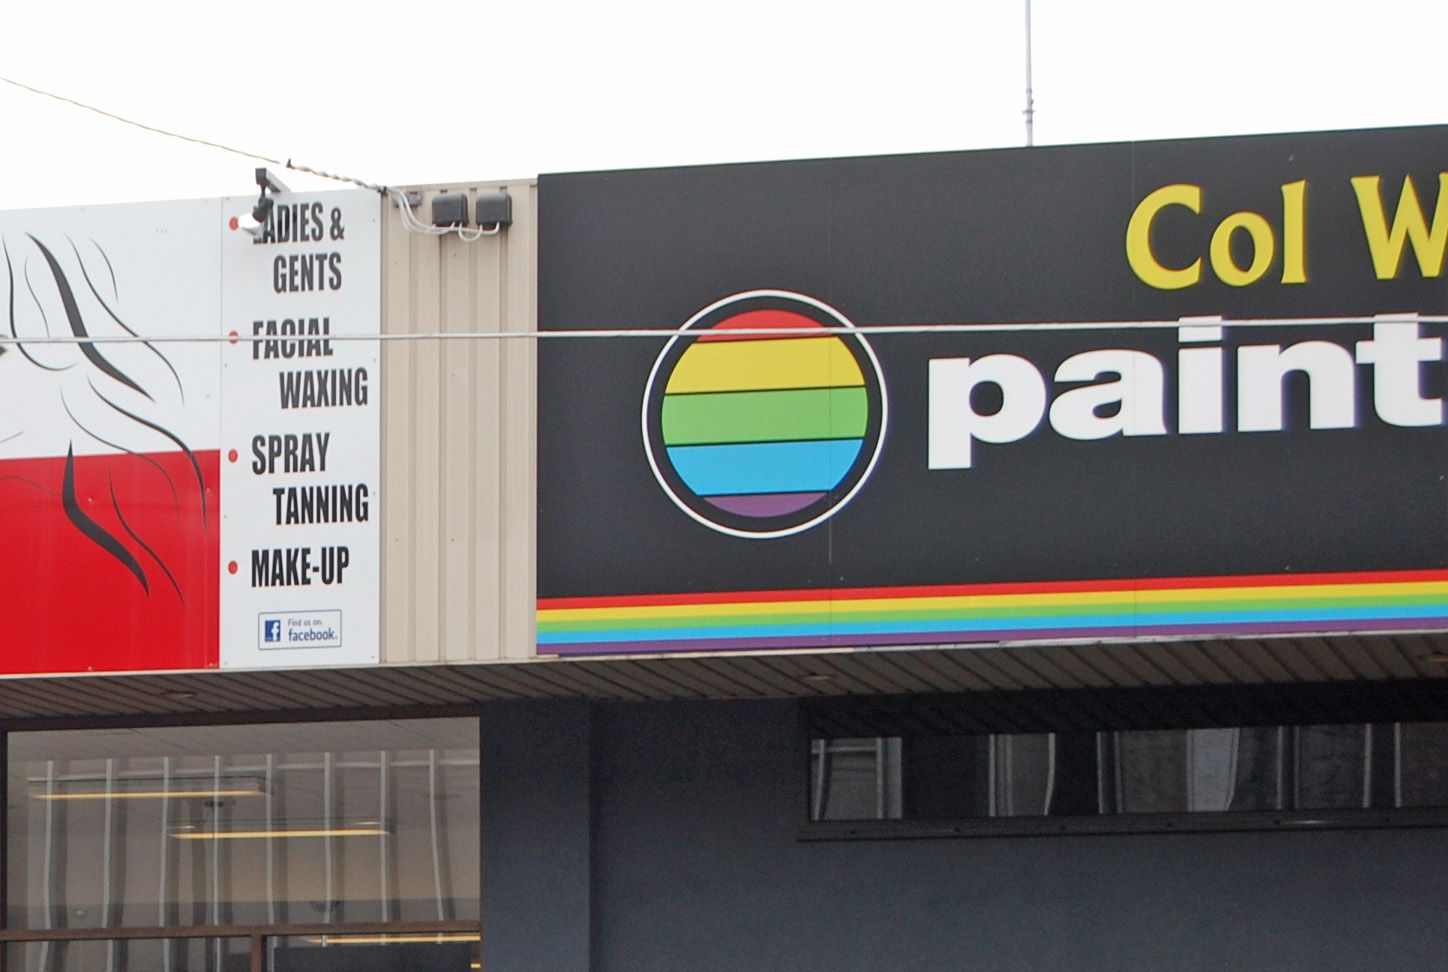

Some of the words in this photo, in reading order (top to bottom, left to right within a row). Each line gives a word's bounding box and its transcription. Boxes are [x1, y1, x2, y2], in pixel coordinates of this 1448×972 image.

[253, 201, 324, 244] ADIES
[330, 207, 345, 240] &
[1126, 179, 1307, 290] Col
[273, 252, 342, 293] GENTS
[253, 317, 333, 360] FACIAL
[279, 367, 368, 409] WAXING
[928, 312, 1443, 469] paint
[252, 432, 330, 475] SPRAY
[272, 483, 369, 526] TANNING
[252, 546, 349, 588] MAKE-UP
[288, 618, 302, 626] Find
